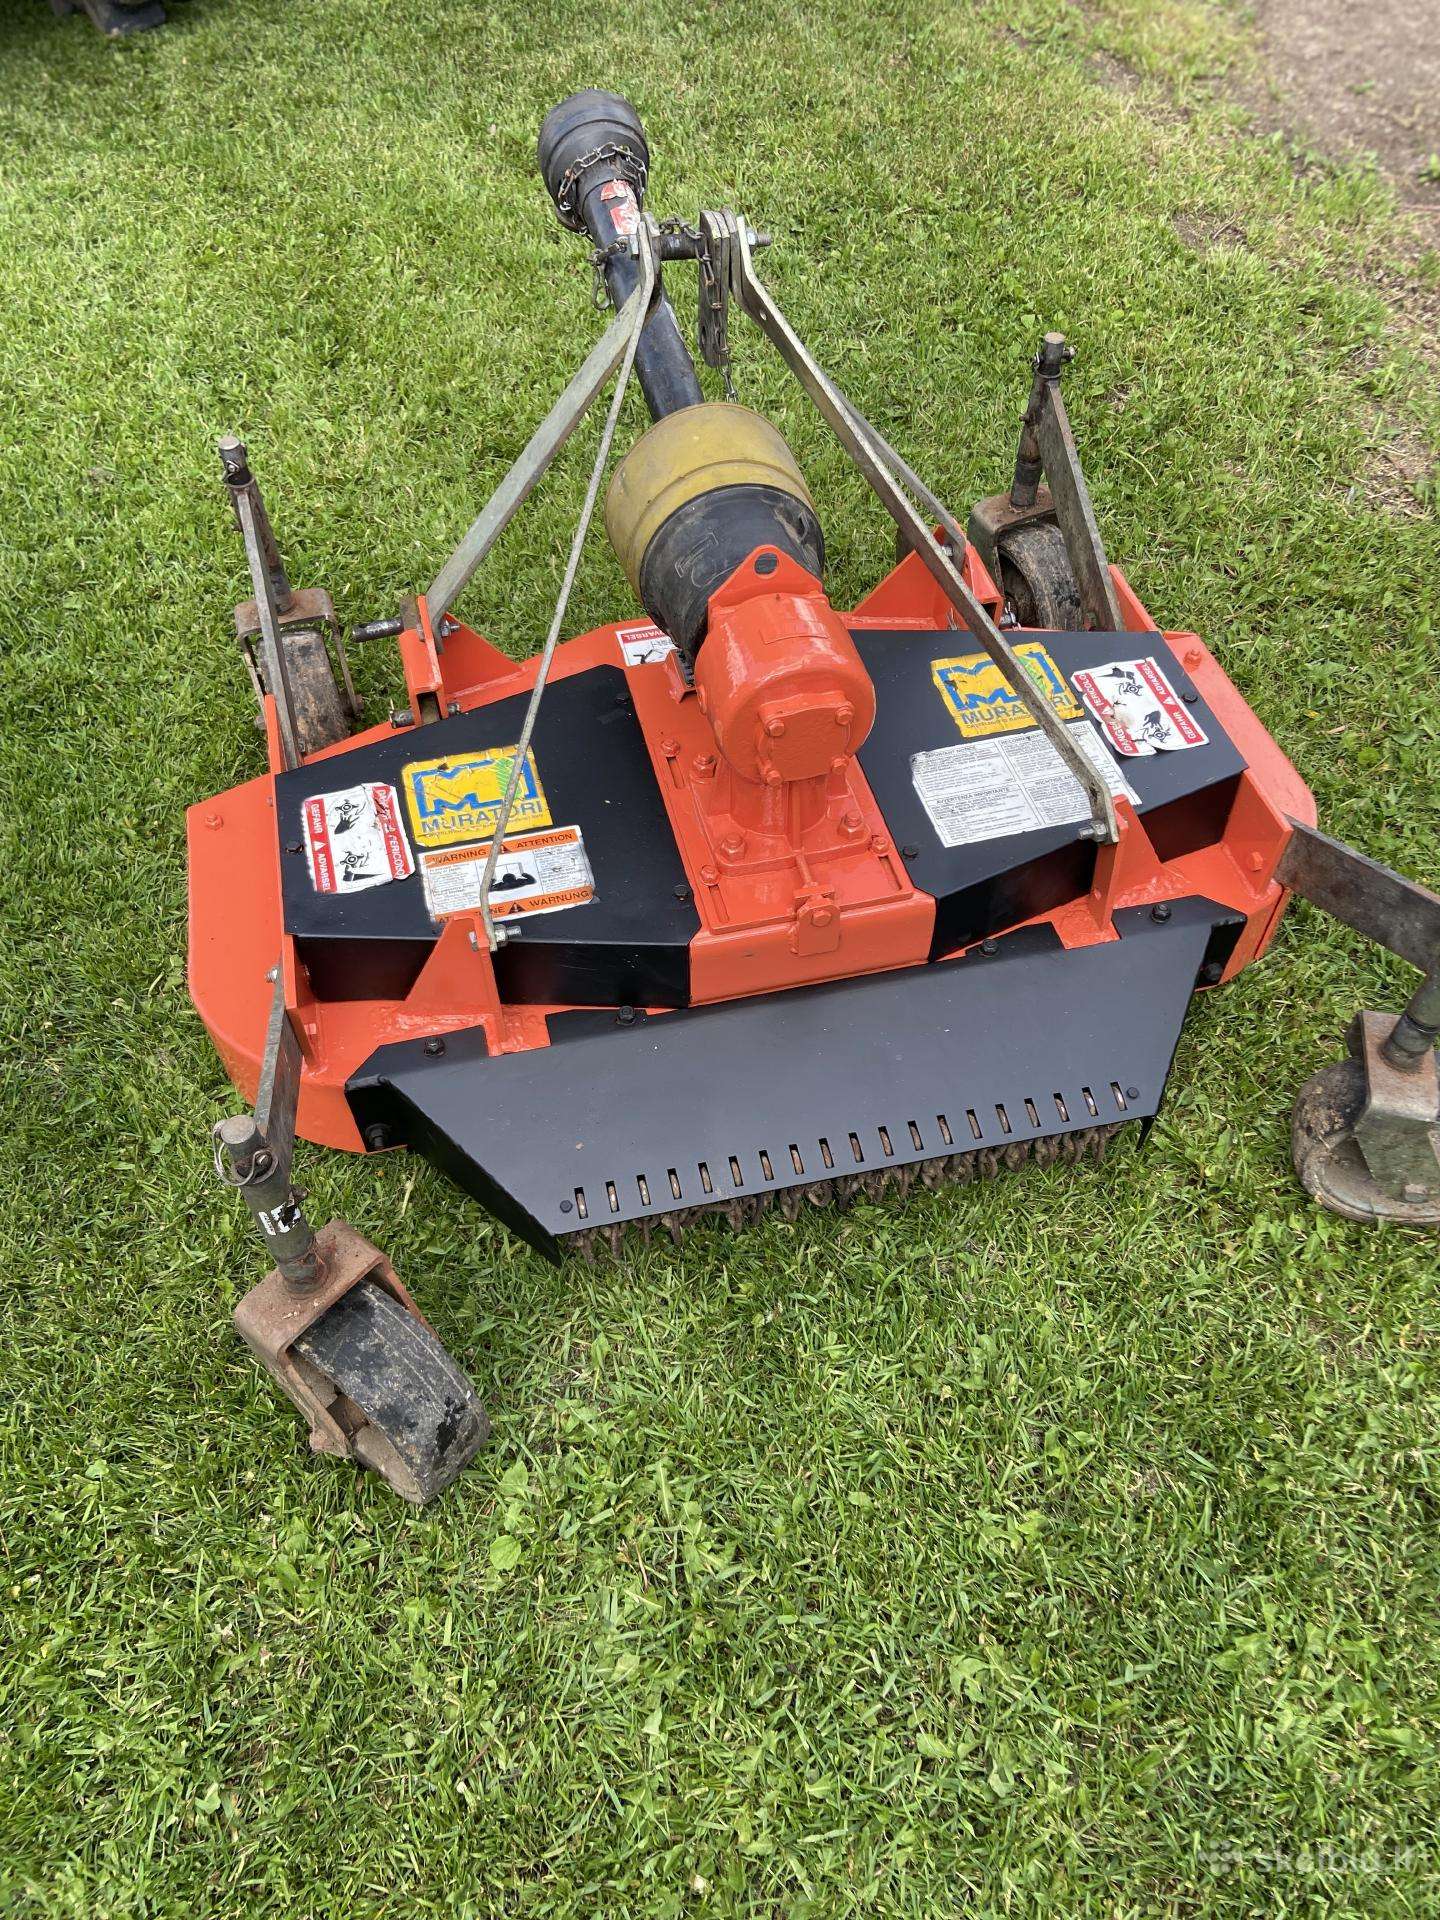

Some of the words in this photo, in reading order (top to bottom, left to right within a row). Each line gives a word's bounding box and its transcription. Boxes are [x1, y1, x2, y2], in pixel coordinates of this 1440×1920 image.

[1172, 711, 1196, 739] GEFAHR
[311, 803, 323, 834] GEFAHR
[432, 848, 487, 864] WARNING
[517, 833, 573, 848] ATTENTION
[529, 890, 589, 907] WARNUNG
